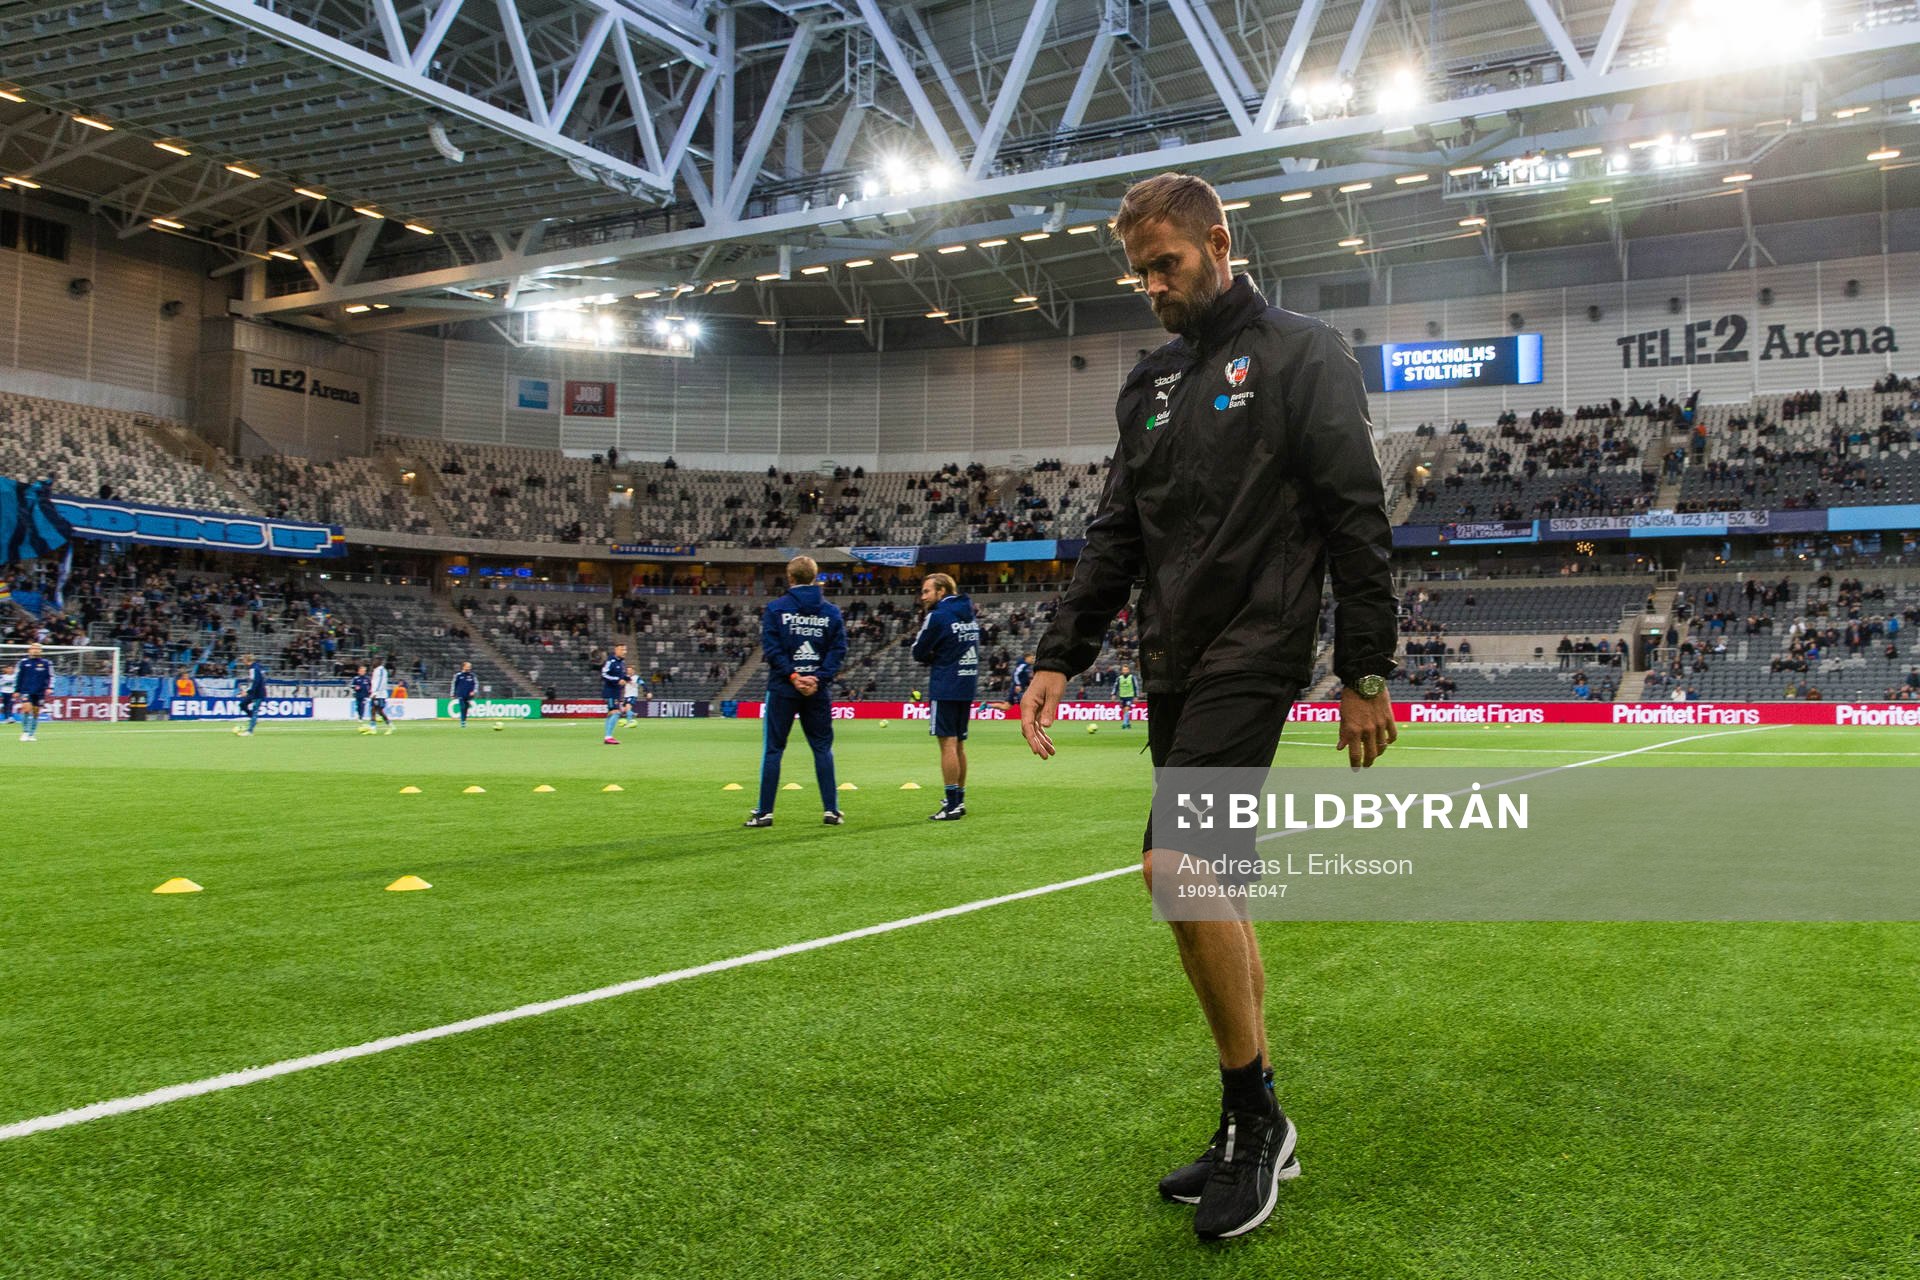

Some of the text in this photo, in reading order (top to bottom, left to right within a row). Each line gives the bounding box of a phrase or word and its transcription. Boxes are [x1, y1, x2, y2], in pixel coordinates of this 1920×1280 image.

[1616, 314, 1898, 368] TELE2 Arena
[1391, 345, 1496, 367] STOCKHOLMS
[1404, 362, 1483, 382] STOLTHET
[252, 368, 360, 404] TELE2 Arena
[575, 386, 603, 402] JOB
[573, 403, 605, 414] ZONE
[1229, 398, 1246, 409] Bank
[1681, 513, 1702, 527] 123
[1728, 512, 1746, 526] 52
[781, 613, 830, 627] Prioritet
[789, 624, 824, 637] Finans
[171, 700, 312, 716] ERLANSSON
[661, 701, 695, 718] ENVITE
[832, 704, 855, 719] ans
[1058, 703, 1122, 721] Prioritet
[1297, 703, 1341, 722] Finan
[1410, 703, 1544, 723] Prioritet Finans
[1612, 703, 1760, 724] Prioritet Finans
[1836, 704, 1920, 725] Priorite
